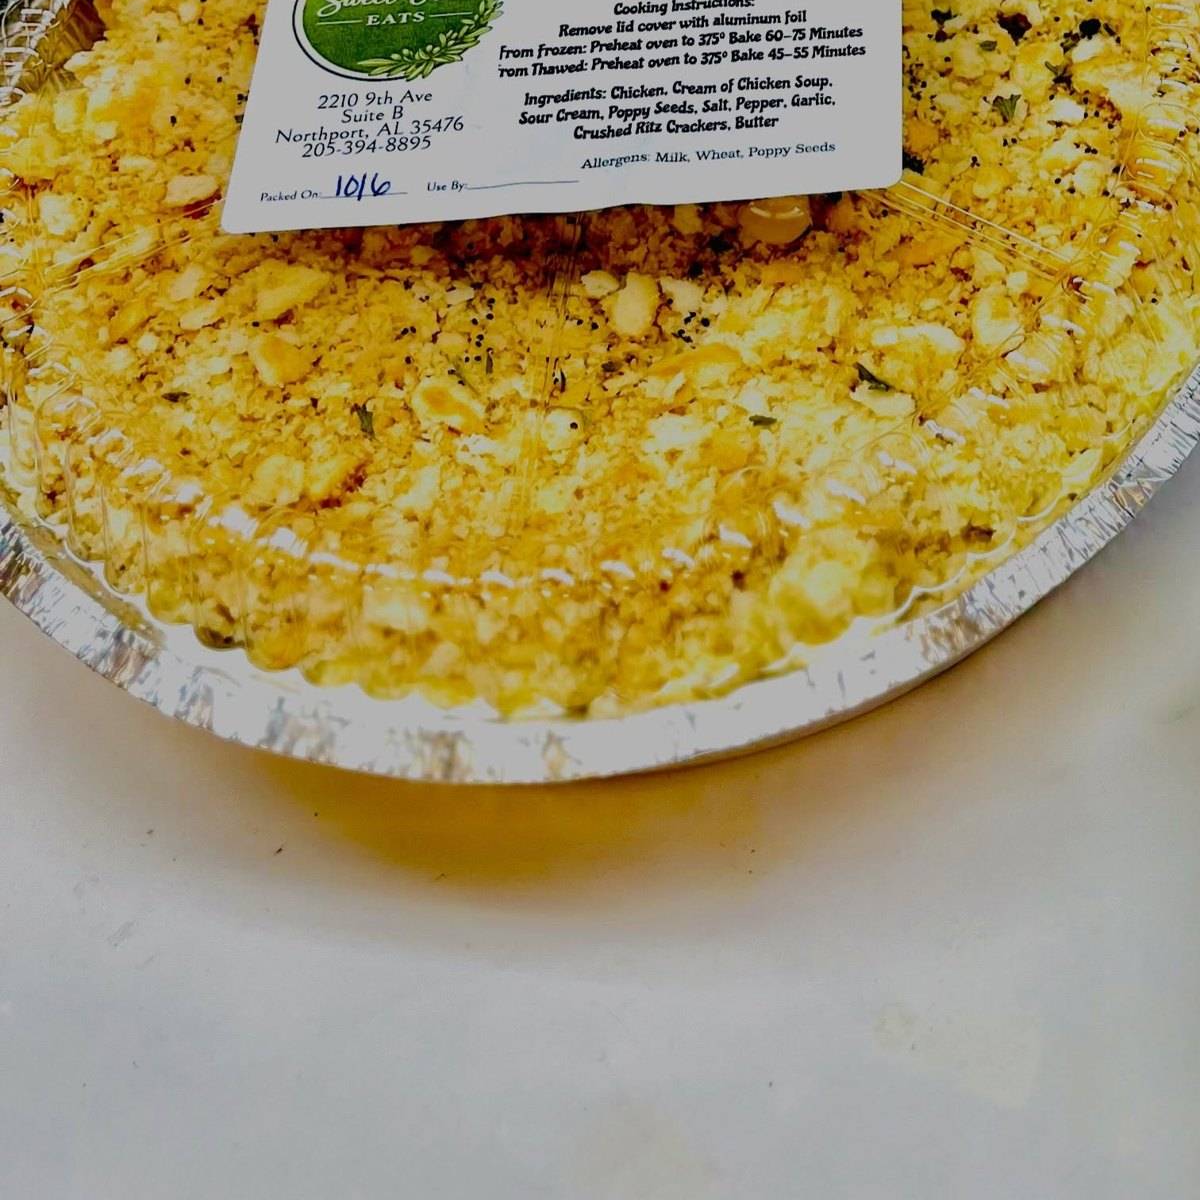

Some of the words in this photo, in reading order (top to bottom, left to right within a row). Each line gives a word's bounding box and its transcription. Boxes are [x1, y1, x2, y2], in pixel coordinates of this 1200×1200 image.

[365, 11, 425, 26] EATS
[613, 1, 668, 17] Cooking
[558, 24, 612, 38] Remove
[616, 20, 634, 33] lid
[637, 19, 676, 31] cover
[679, 15, 709, 30] with
[713, 13, 781, 27] aluminum
[785, 10, 807, 25] foil
[499, 45, 533, 60] From
[537, 44, 587, 59] Frozen:
[590, 38, 642, 53] Preheat
[646, 37, 678, 50] oven
[682, 35, 695, 46] to
[729, 30, 761, 44] Bake
[809, 26, 863, 41] Minutes
[498, 64, 528, 78] rom
[531, 60, 588, 76] Thawed:
[591, 56, 644, 71] Preheat
[648, 55, 680, 68] oven
[684, 52, 697, 65] to
[731, 48, 764, 62] Bake
[811, 44, 866, 59] Minutes
[317, 93, 359, 109] 2210
[365, 90, 393, 106] 9th
[400, 89, 433, 103] Ave
[524, 87, 607, 108] Ingredients:
[672, 80, 717, 95] Cream
[720, 78, 734, 93] of
[737, 77, 791, 91] Chicken
[341, 109, 385, 123] Suite
[392, 105, 404, 119] B
[519, 111, 552, 125] Sour
[556, 109, 604, 122] Cream,
[608, 105, 650, 122] Poppy
[654, 100, 698, 115] Seeds,
[702, 99, 732, 113] Salt,
[275, 126, 369, 145] Northport,
[376, 121, 404, 137] AL
[409, 115, 464, 134] 35476
[573, 123, 632, 140] Crushed
[635, 121, 662, 135] Ritz
[666, 118, 731, 133] Crackers,
[735, 115, 779, 130] Butter
[302, 135, 432, 158] 205-394-8895
[580, 152, 650, 169] Allergens:
[655, 151, 690, 163] Milk,
[696, 149, 744, 161] Wheat,
[748, 145, 791, 158] Poppy
[795, 141, 836, 154] Seeds
[260, 191, 297, 202] Packed
[335, 172, 391, 201] 10/6
[427, 182, 447, 192] Use
